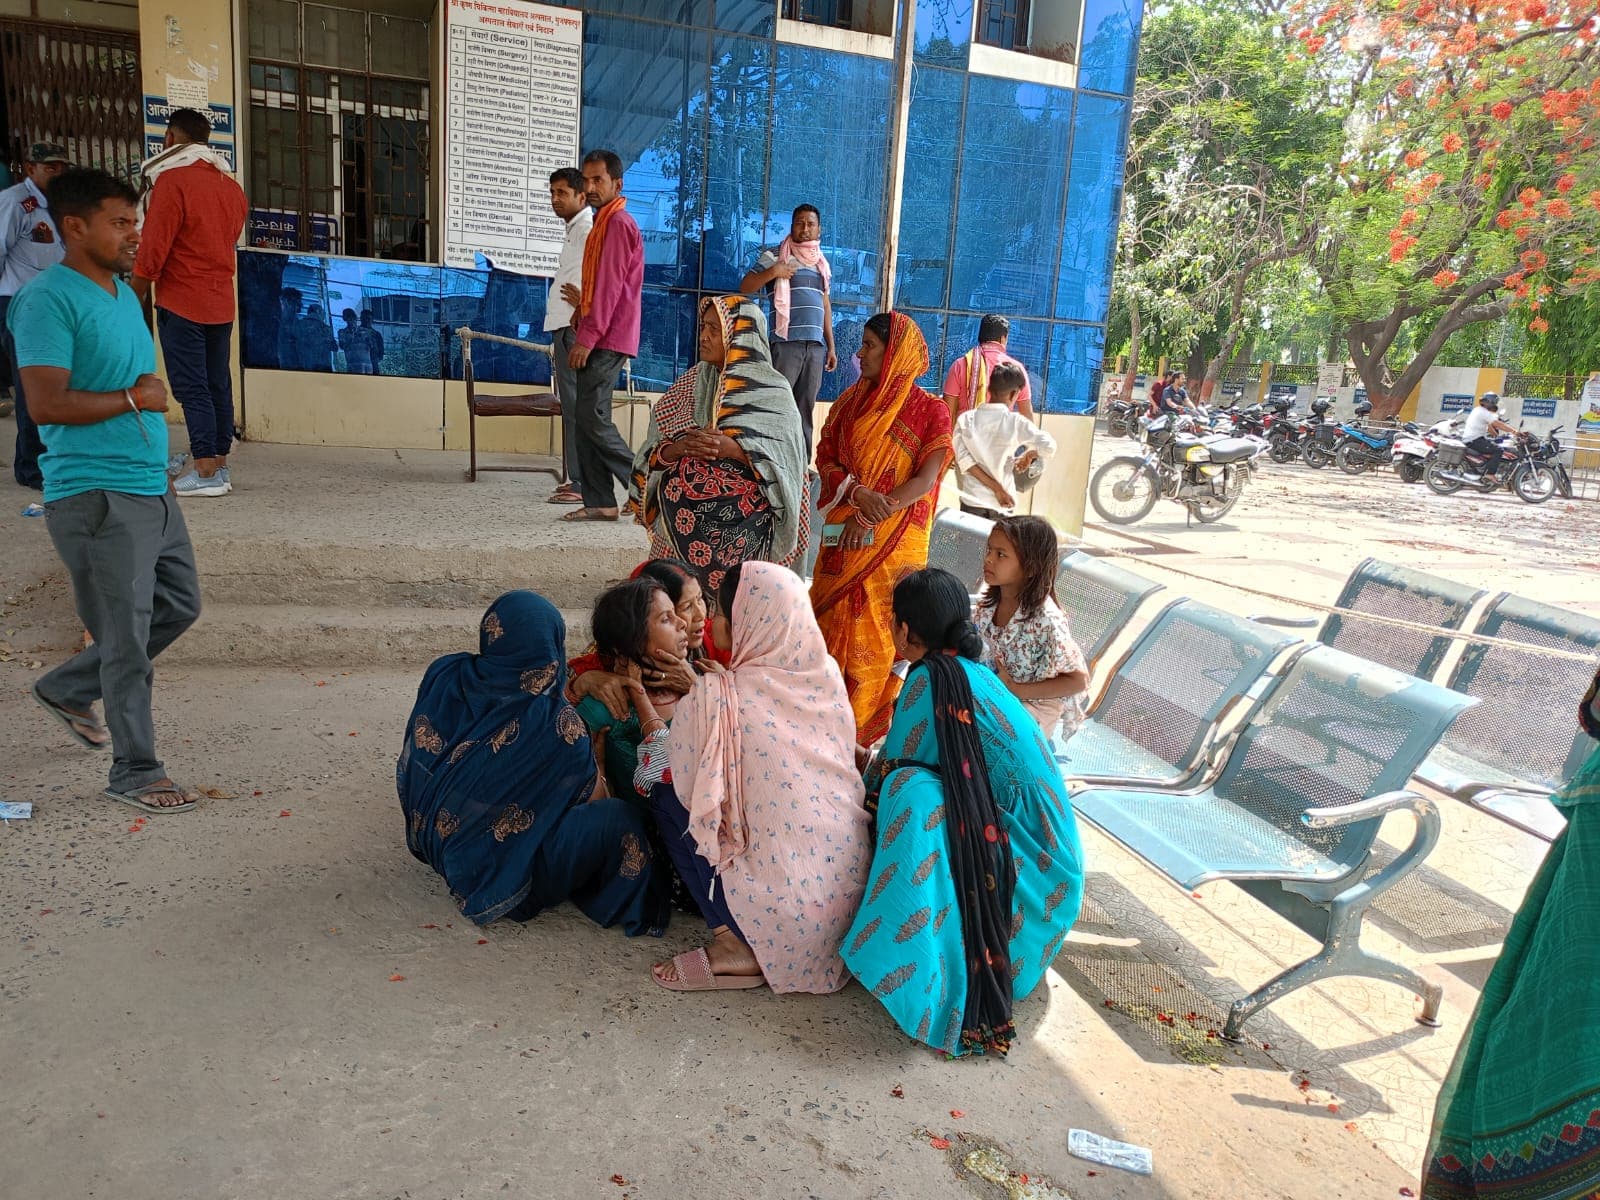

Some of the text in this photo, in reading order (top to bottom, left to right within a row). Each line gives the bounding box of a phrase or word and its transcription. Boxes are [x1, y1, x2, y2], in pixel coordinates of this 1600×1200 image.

[490, 33, 528, 47] (Service)
[498, 50, 528, 60] (Surgery)
[498, 75, 529, 86] (Medicine)
[500, 177, 519, 185] (Eye)
